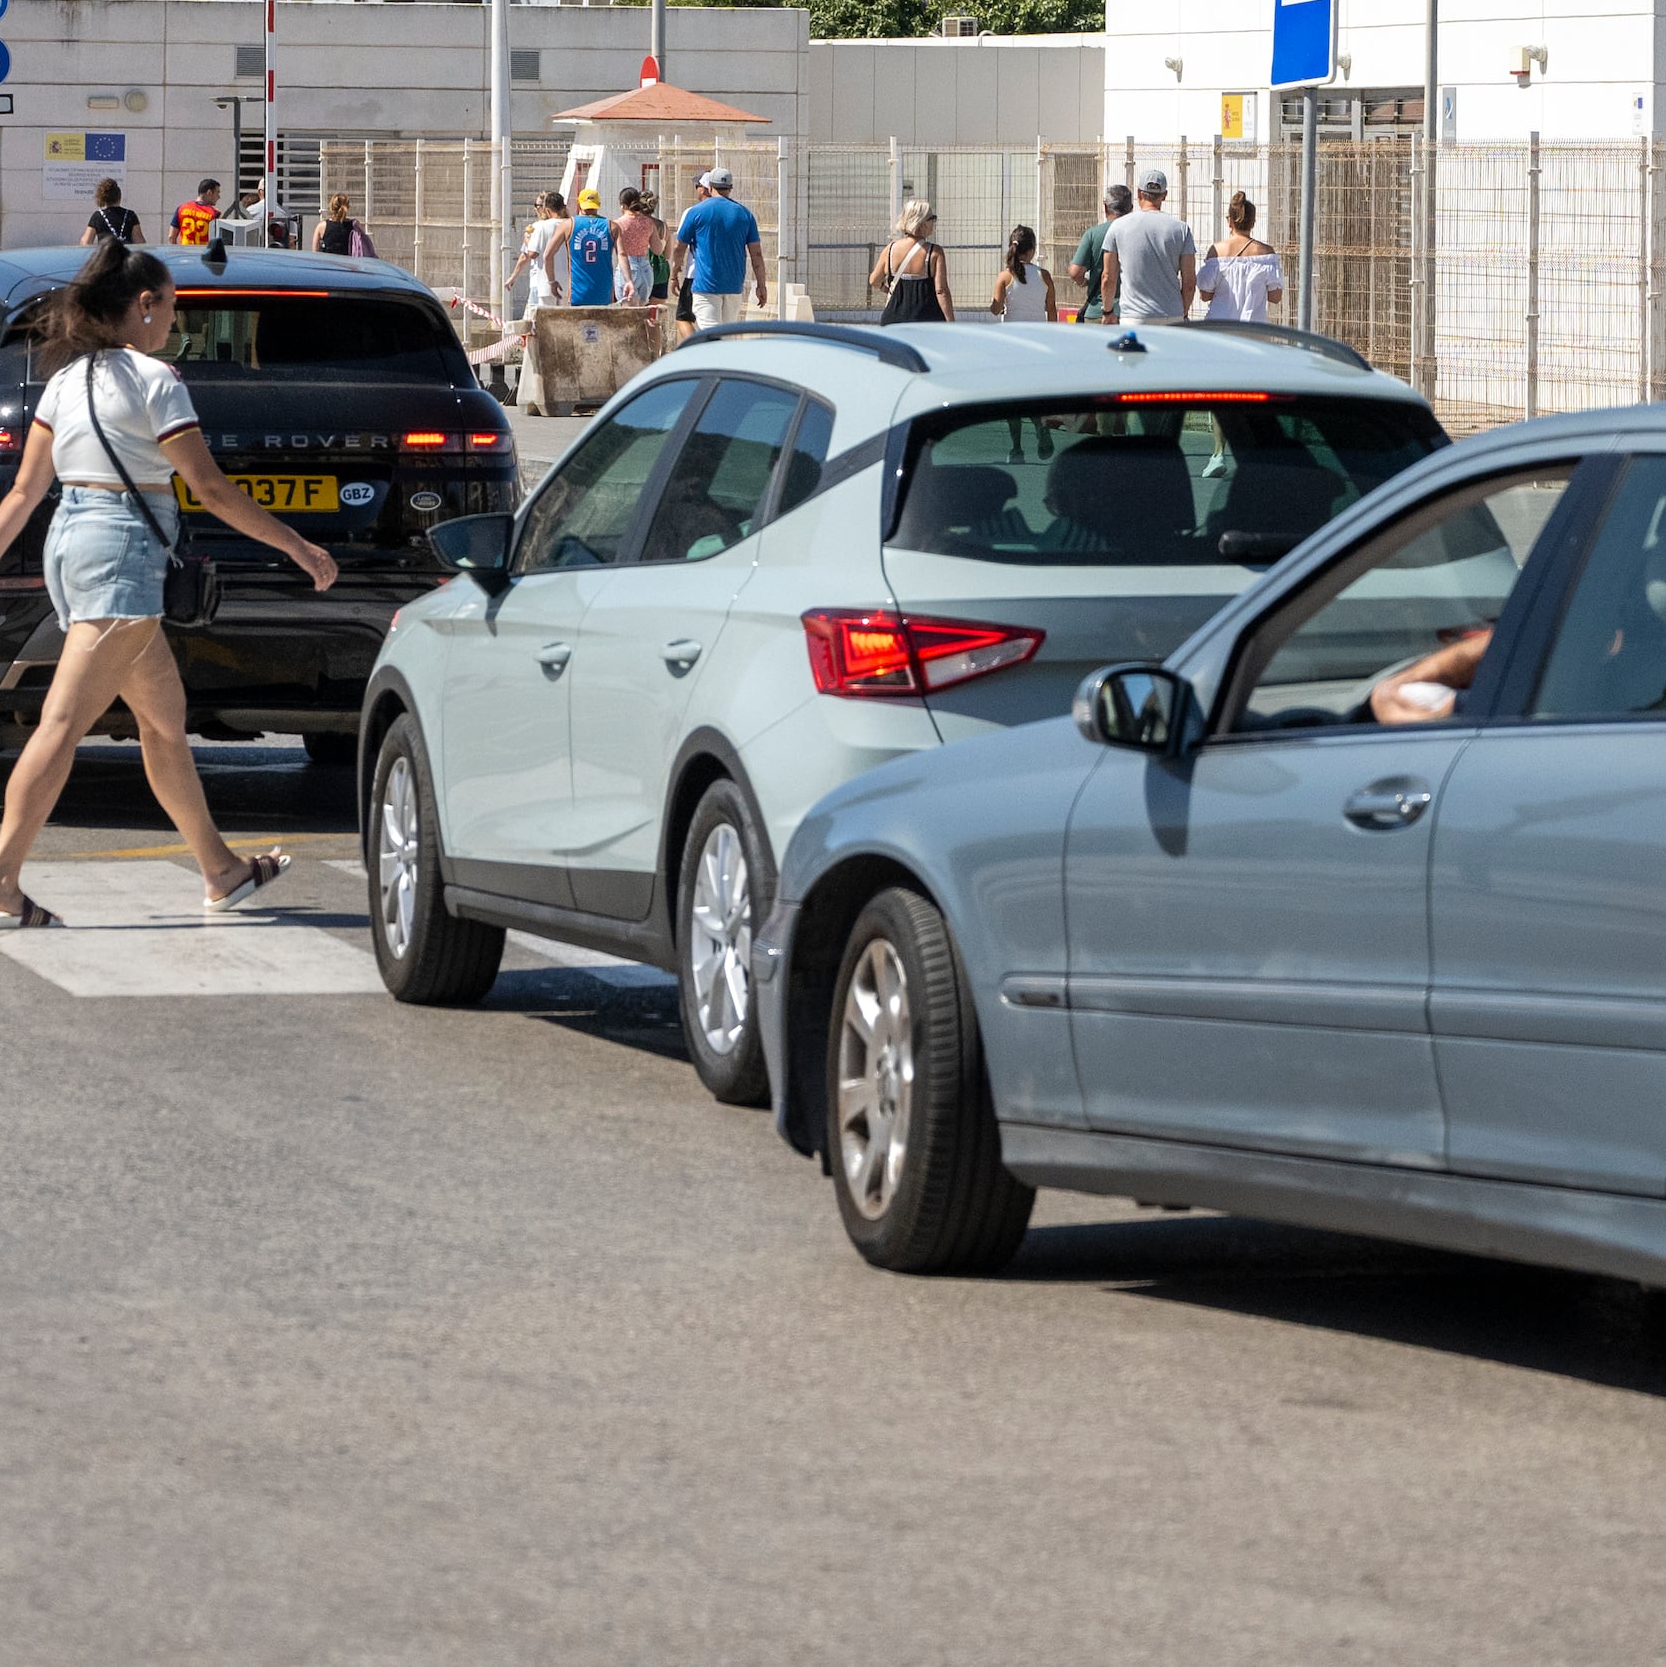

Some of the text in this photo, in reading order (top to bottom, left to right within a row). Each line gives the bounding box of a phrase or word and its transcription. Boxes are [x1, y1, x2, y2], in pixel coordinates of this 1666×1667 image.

[182, 217, 209, 245] 22
[585, 240, 597, 263] 2
[265, 434, 388, 448] ROVER
[342, 487, 371, 501] GBZ
